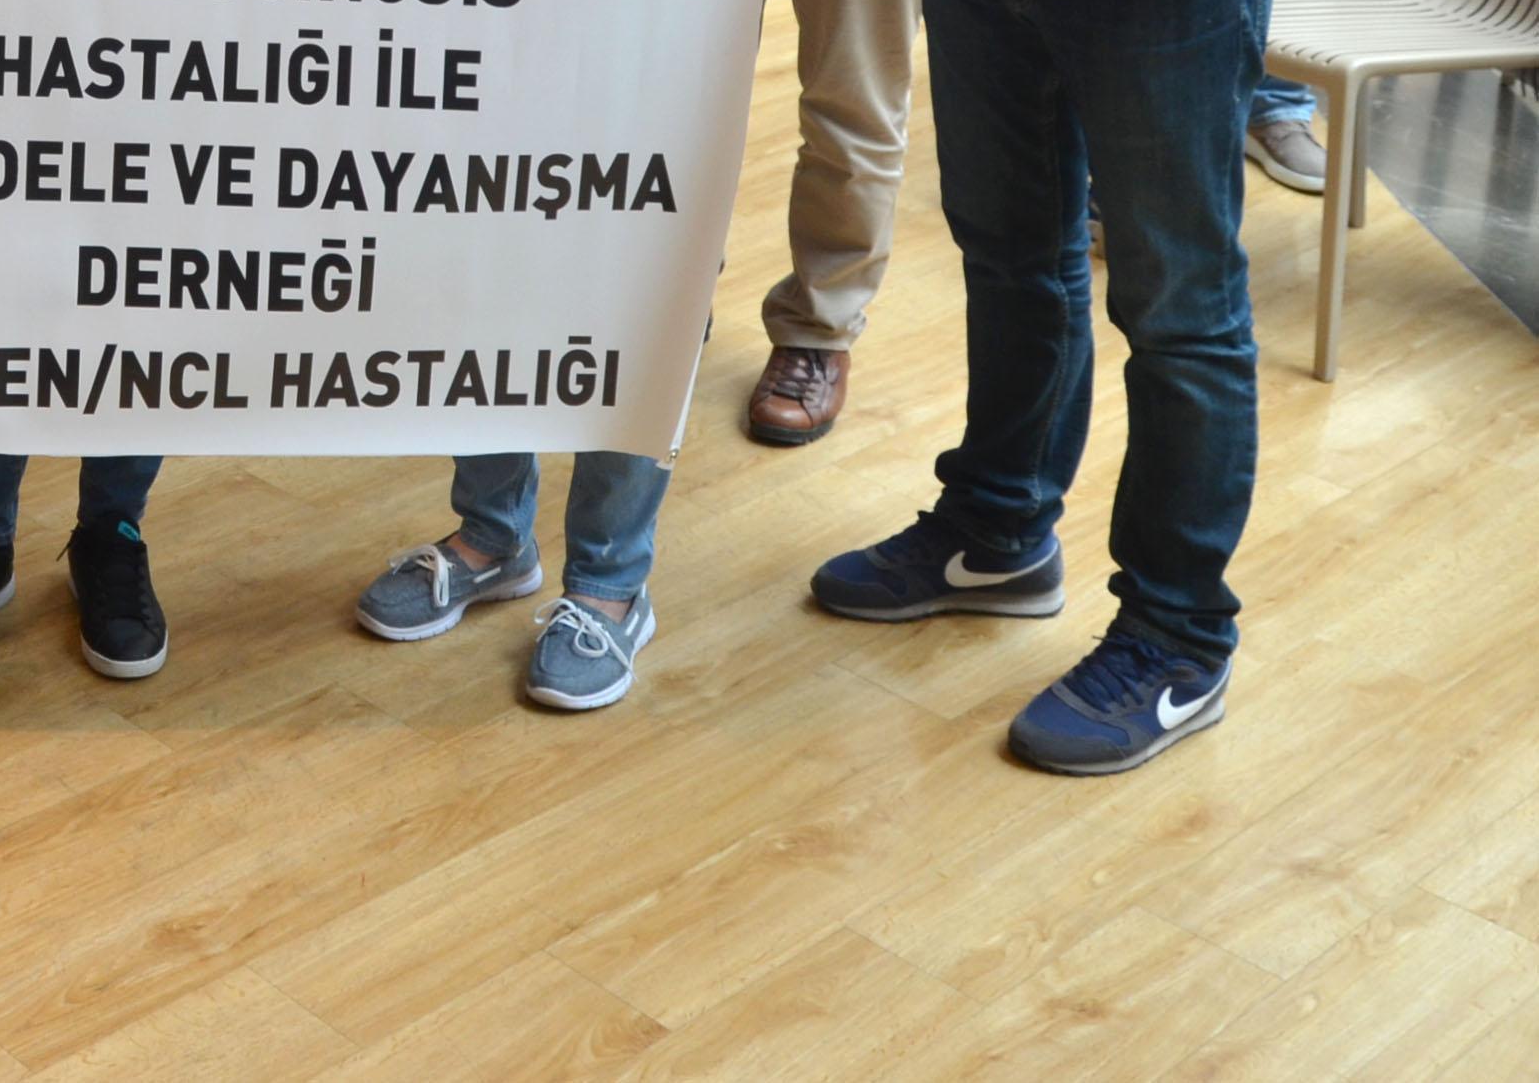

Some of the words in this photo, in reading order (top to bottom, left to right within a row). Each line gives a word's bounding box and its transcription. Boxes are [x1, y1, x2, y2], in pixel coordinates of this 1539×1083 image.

[377, 29, 480, 110] İLE
[171, 145, 254, 206] VE
[278, 148, 676, 219] DAYANIŞMA
[78, 237, 375, 312] DERNEĞİ
[271, 337, 619, 407] HASTALIĞI
